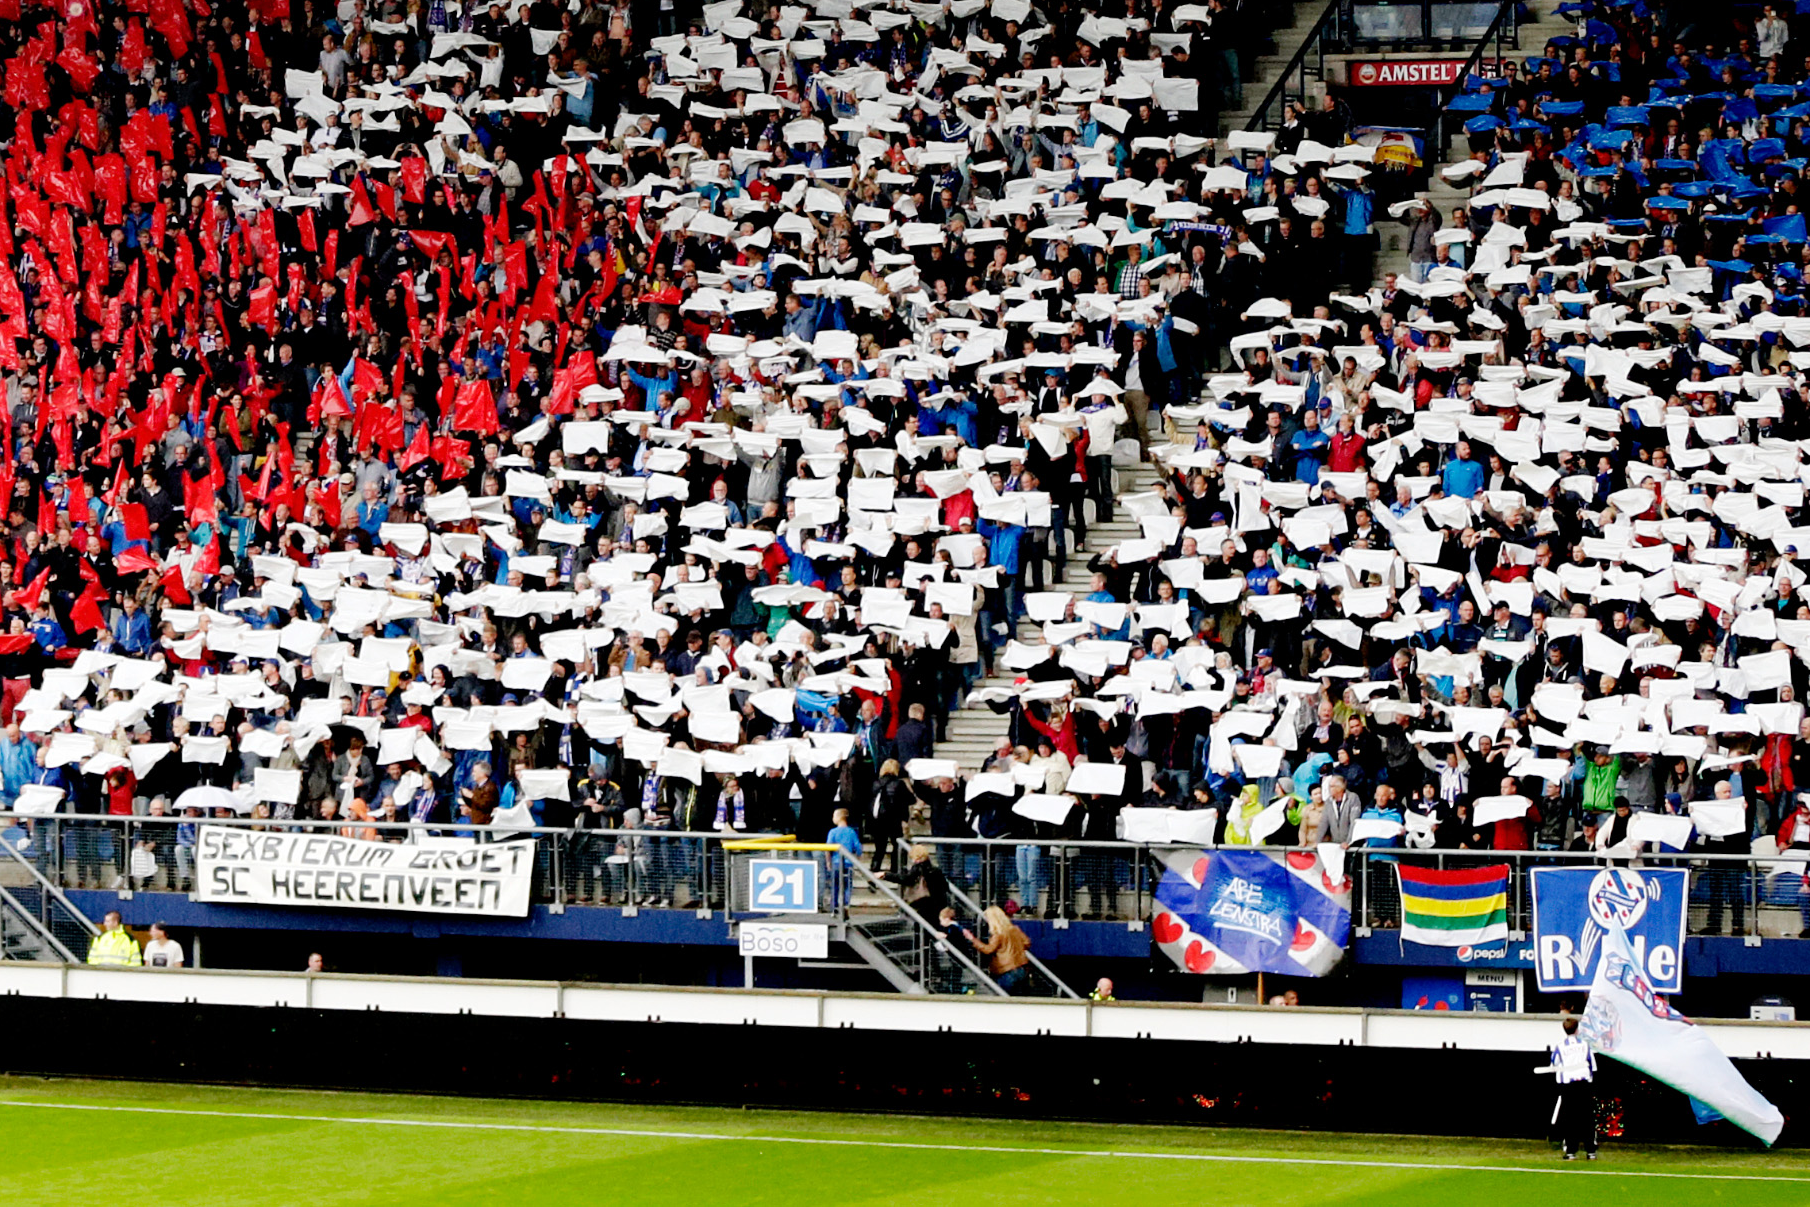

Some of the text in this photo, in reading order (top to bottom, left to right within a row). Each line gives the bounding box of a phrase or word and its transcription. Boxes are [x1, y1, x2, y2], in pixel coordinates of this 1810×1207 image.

[1378, 64, 1450, 82] AMSTEL
[202, 832, 528, 876] SEXBIERUM GROET
[211, 866, 250, 896] SC
[757, 867, 804, 905] 21
[1222, 877, 1263, 904] ABE
[1210, 899, 1282, 936] LENSTRA
[741, 932, 798, 953] Boso
[1477, 974, 1504, 983] MENU
